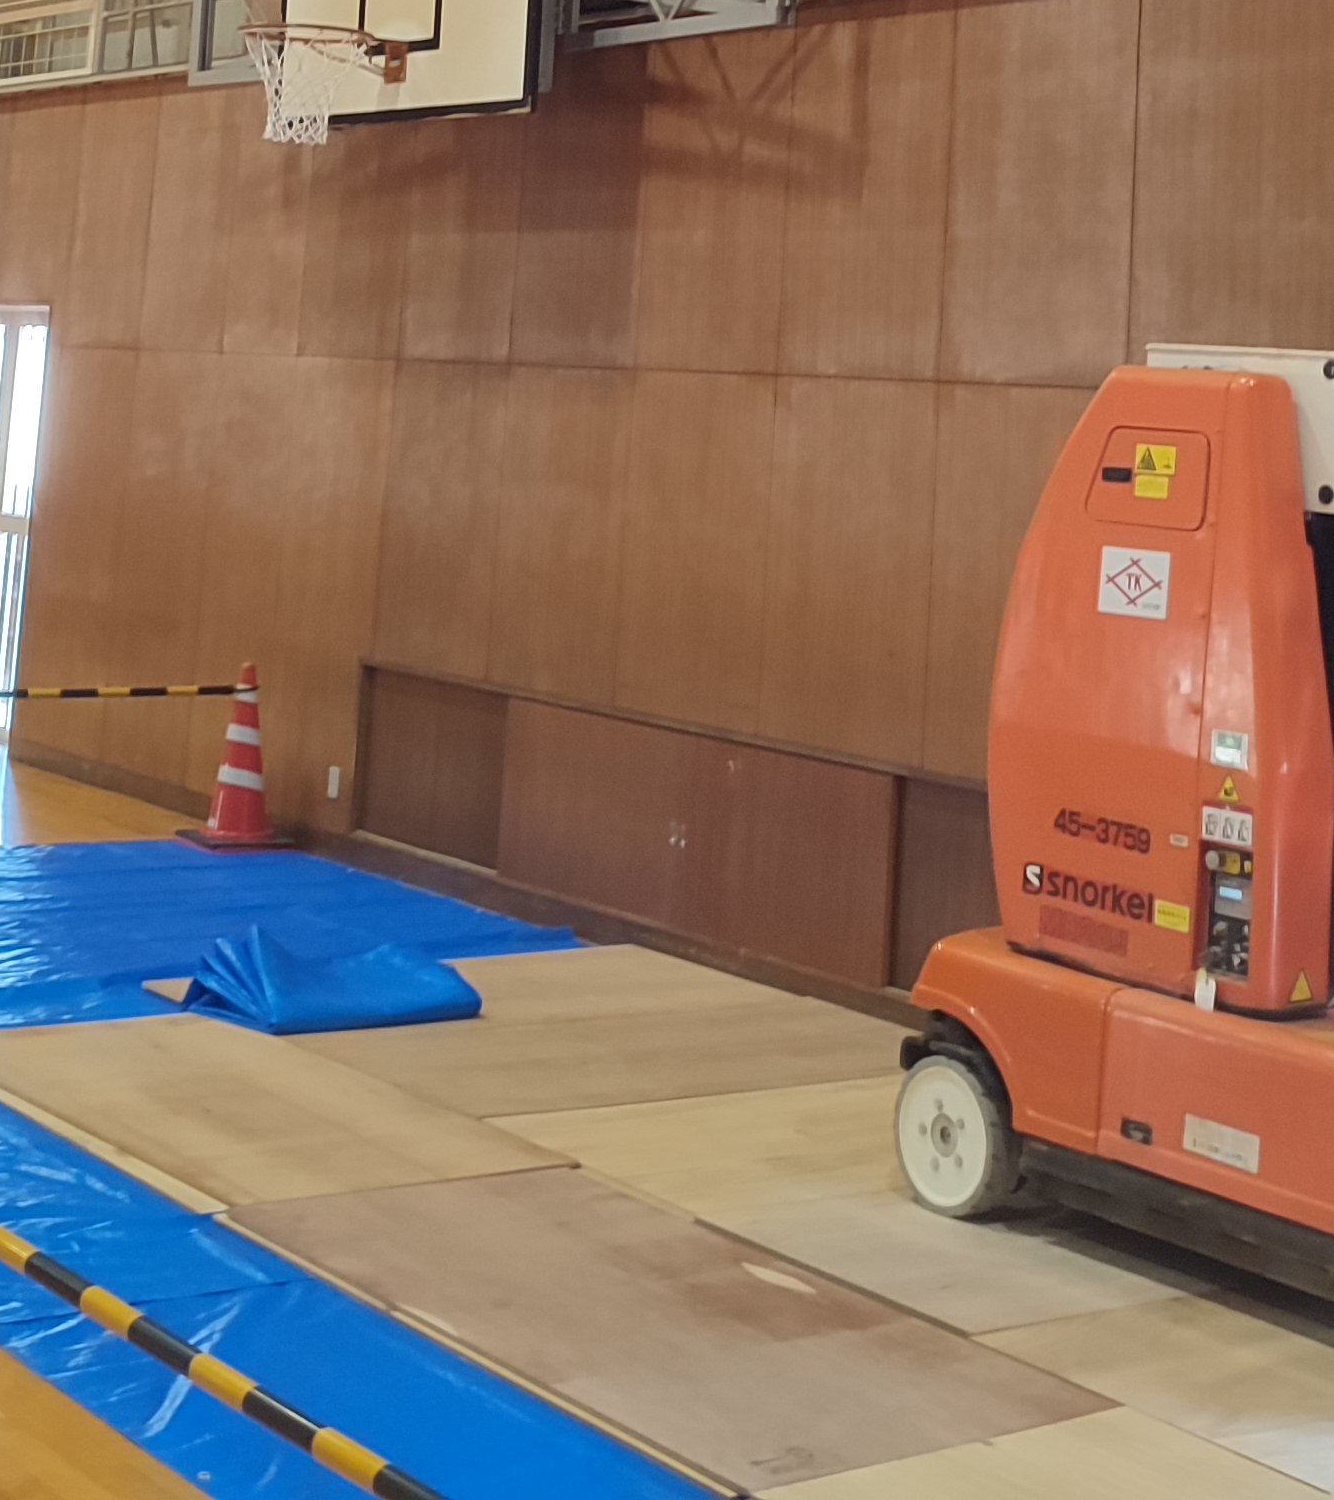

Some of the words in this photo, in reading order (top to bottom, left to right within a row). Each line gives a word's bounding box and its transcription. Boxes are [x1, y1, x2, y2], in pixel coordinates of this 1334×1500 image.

[1126, 574, 1142, 592] TK
[1053, 807, 1151, 854] 45-3759
[1046, 871, 1154, 924] snorkel
